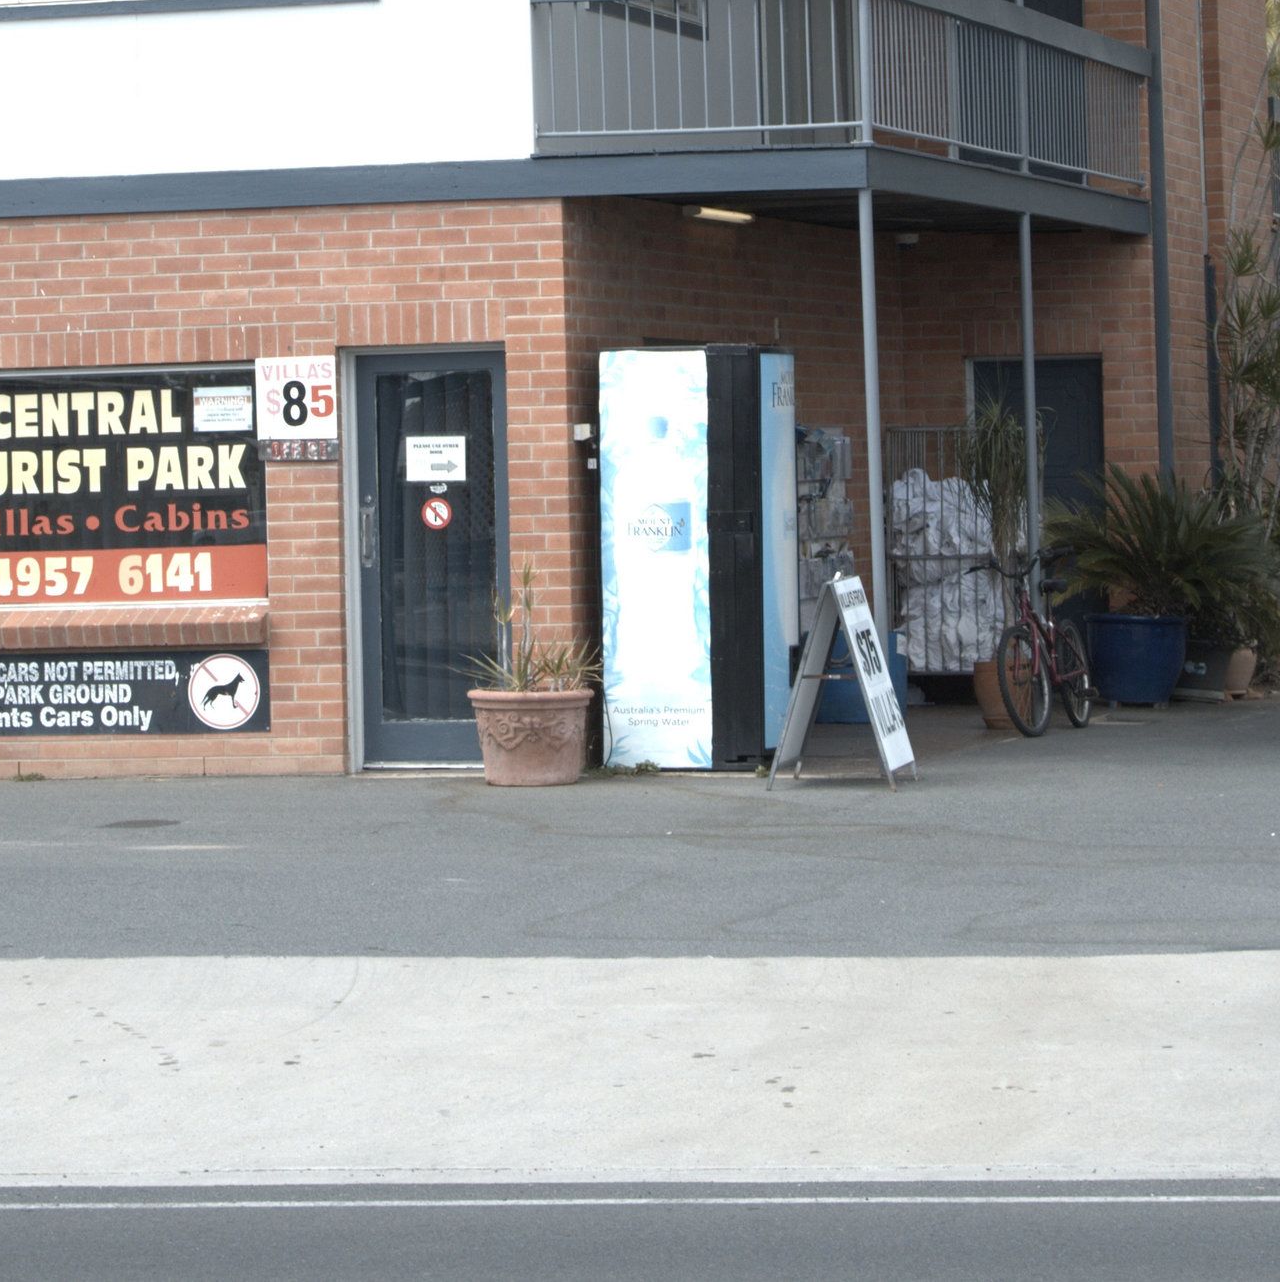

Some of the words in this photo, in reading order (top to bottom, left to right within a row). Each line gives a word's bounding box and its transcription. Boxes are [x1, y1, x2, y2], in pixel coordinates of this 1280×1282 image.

[261, 363, 333, 381] VILLAS
[200, 396, 249, 407] WARNING!
[266, 381, 334, 426] $85
[127, 444, 247, 492] PARK
[115, 503, 250, 532] Cabins
[119, 552, 213, 595] 6141
[855, 628, 883, 682] $75
[43, 661, 78, 683] NOT
[48, 683, 131, 705] GROUND
[40, 706, 95, 728] Cars
[100, 705, 152, 731] Only
[613, 706, 661, 714] Australia's
[664, 706, 705, 714] Premium
[628, 718, 659, 727] Spring
[662, 718, 690, 726] Water
